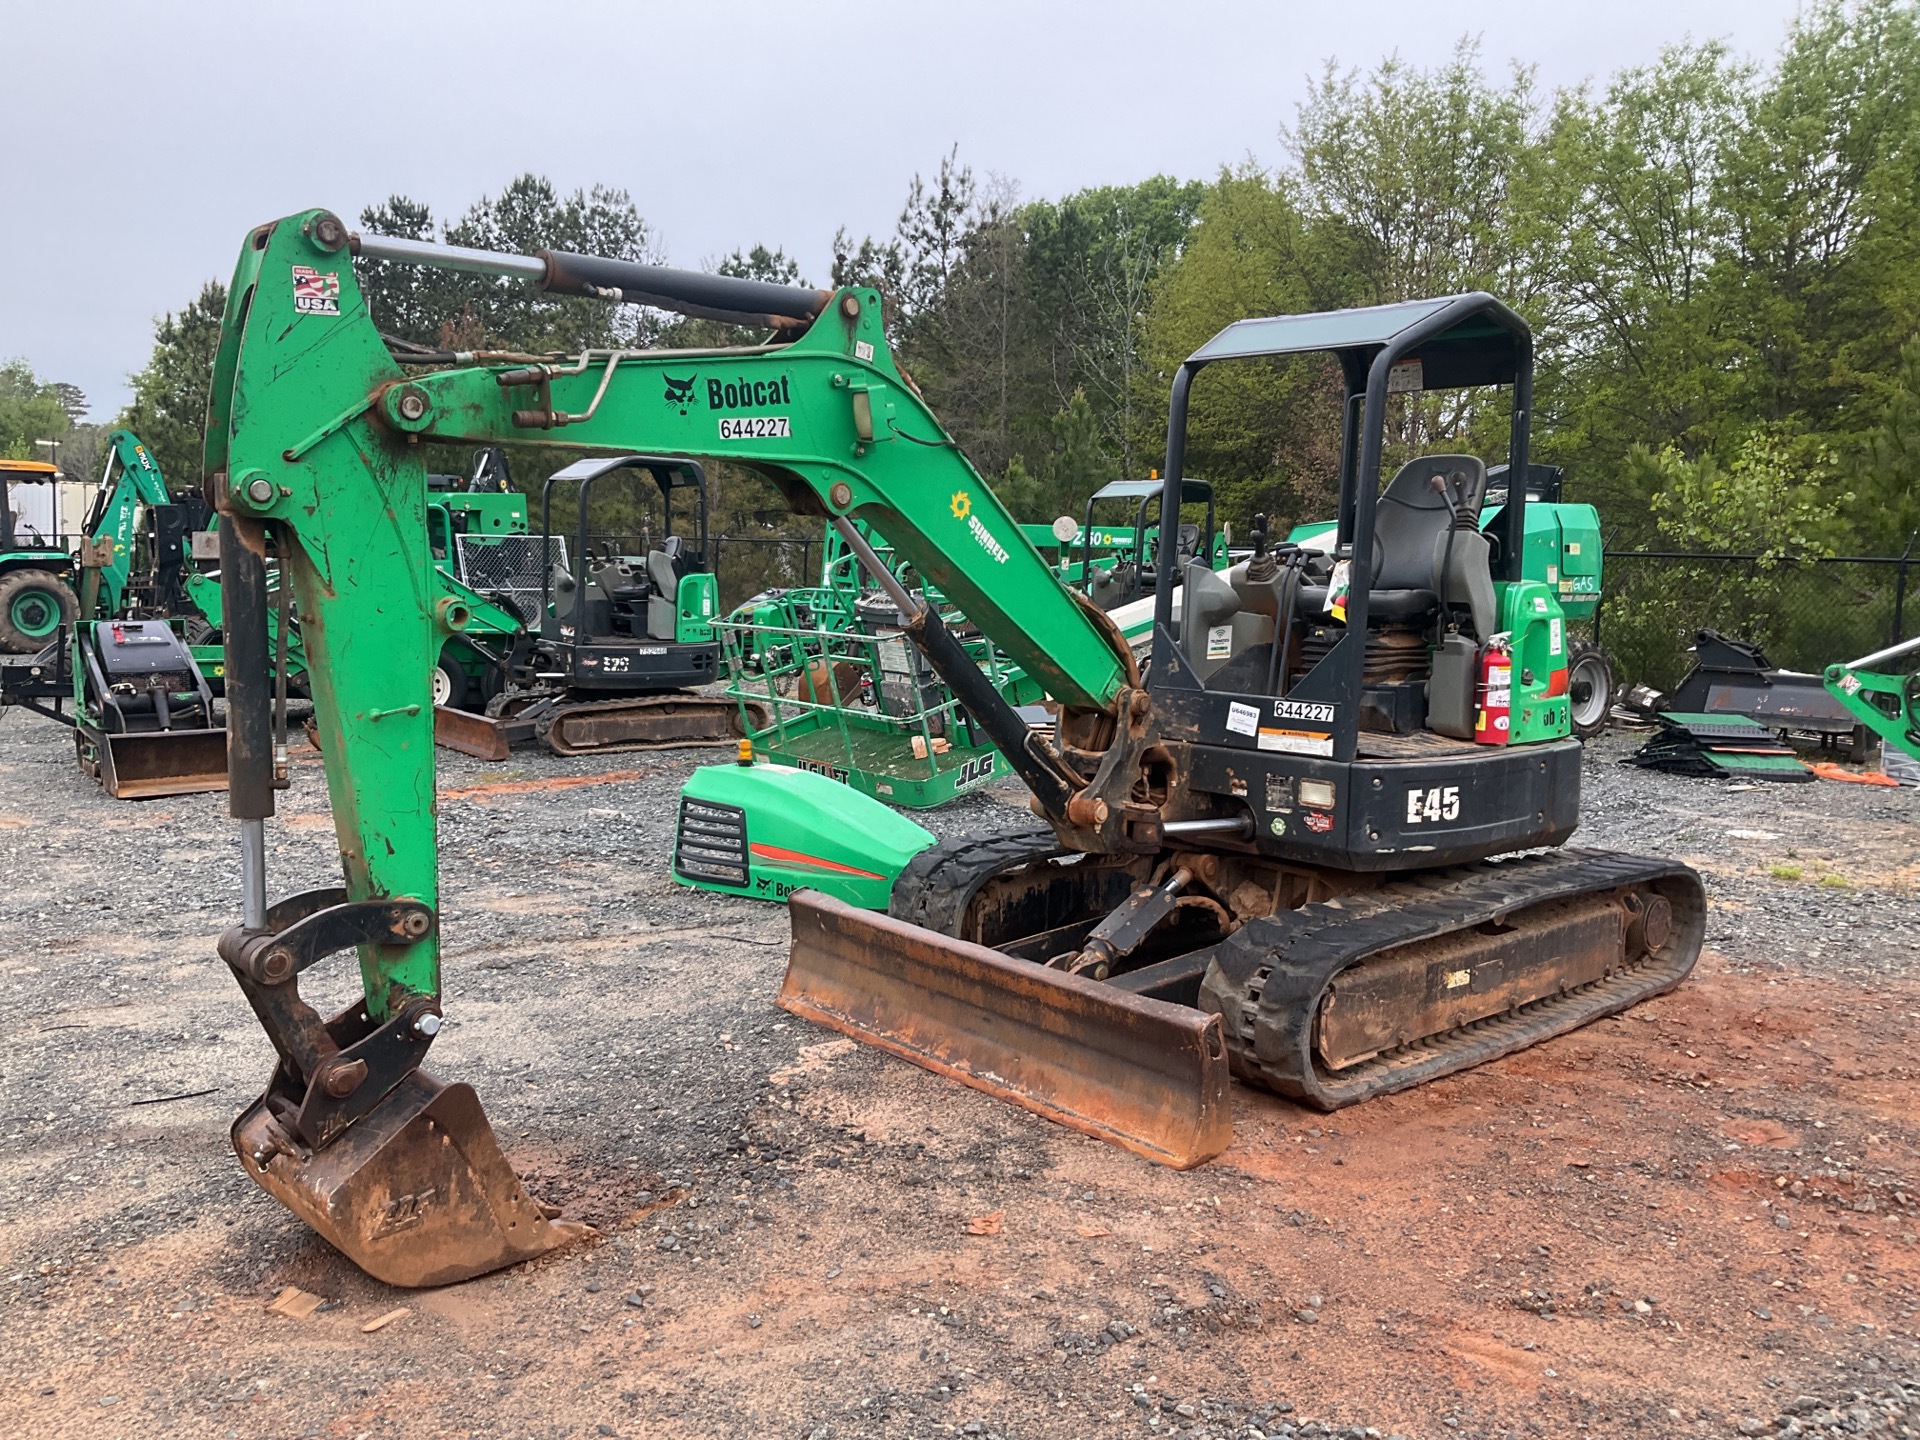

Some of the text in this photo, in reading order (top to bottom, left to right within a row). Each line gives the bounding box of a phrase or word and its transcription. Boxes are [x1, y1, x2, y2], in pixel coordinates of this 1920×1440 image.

[297, 298, 338, 310] USA
[707, 375, 790, 410] Bobcat
[720, 418, 788, 439] 644227
[968, 515, 1010, 565] SUNBELT
[1573, 576, 1594, 592] GAS
[1275, 702, 1333, 721] 644227
[954, 752, 994, 788] JLG
[1406, 786, 1460, 824] E45
